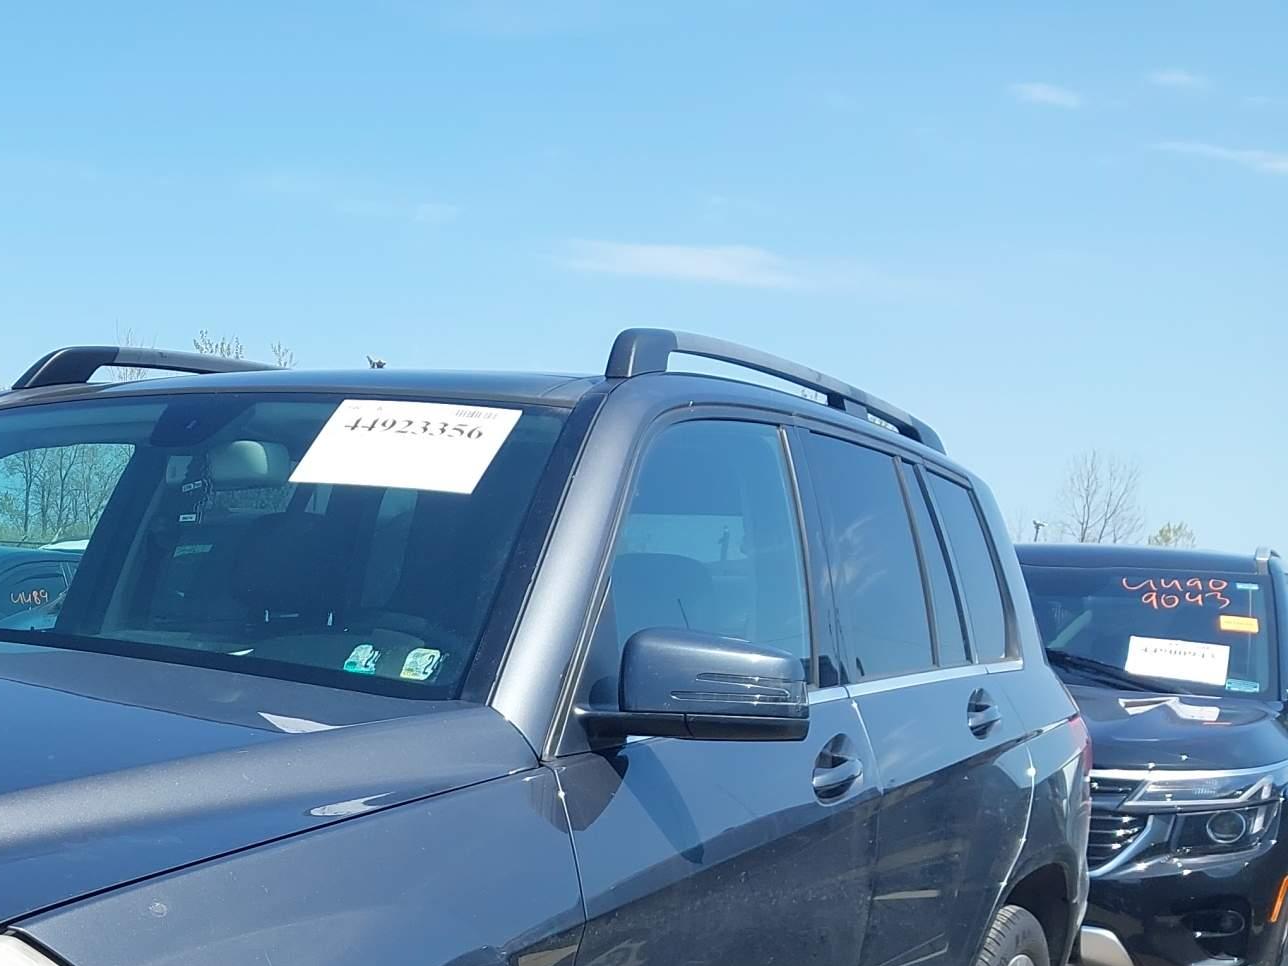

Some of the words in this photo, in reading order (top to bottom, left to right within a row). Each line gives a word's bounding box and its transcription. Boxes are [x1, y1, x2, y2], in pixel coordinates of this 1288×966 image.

[344, 417, 484, 440] 44923356
[1122, 577, 1229, 592] 4490
[1141, 591, 1231, 609] 9043
